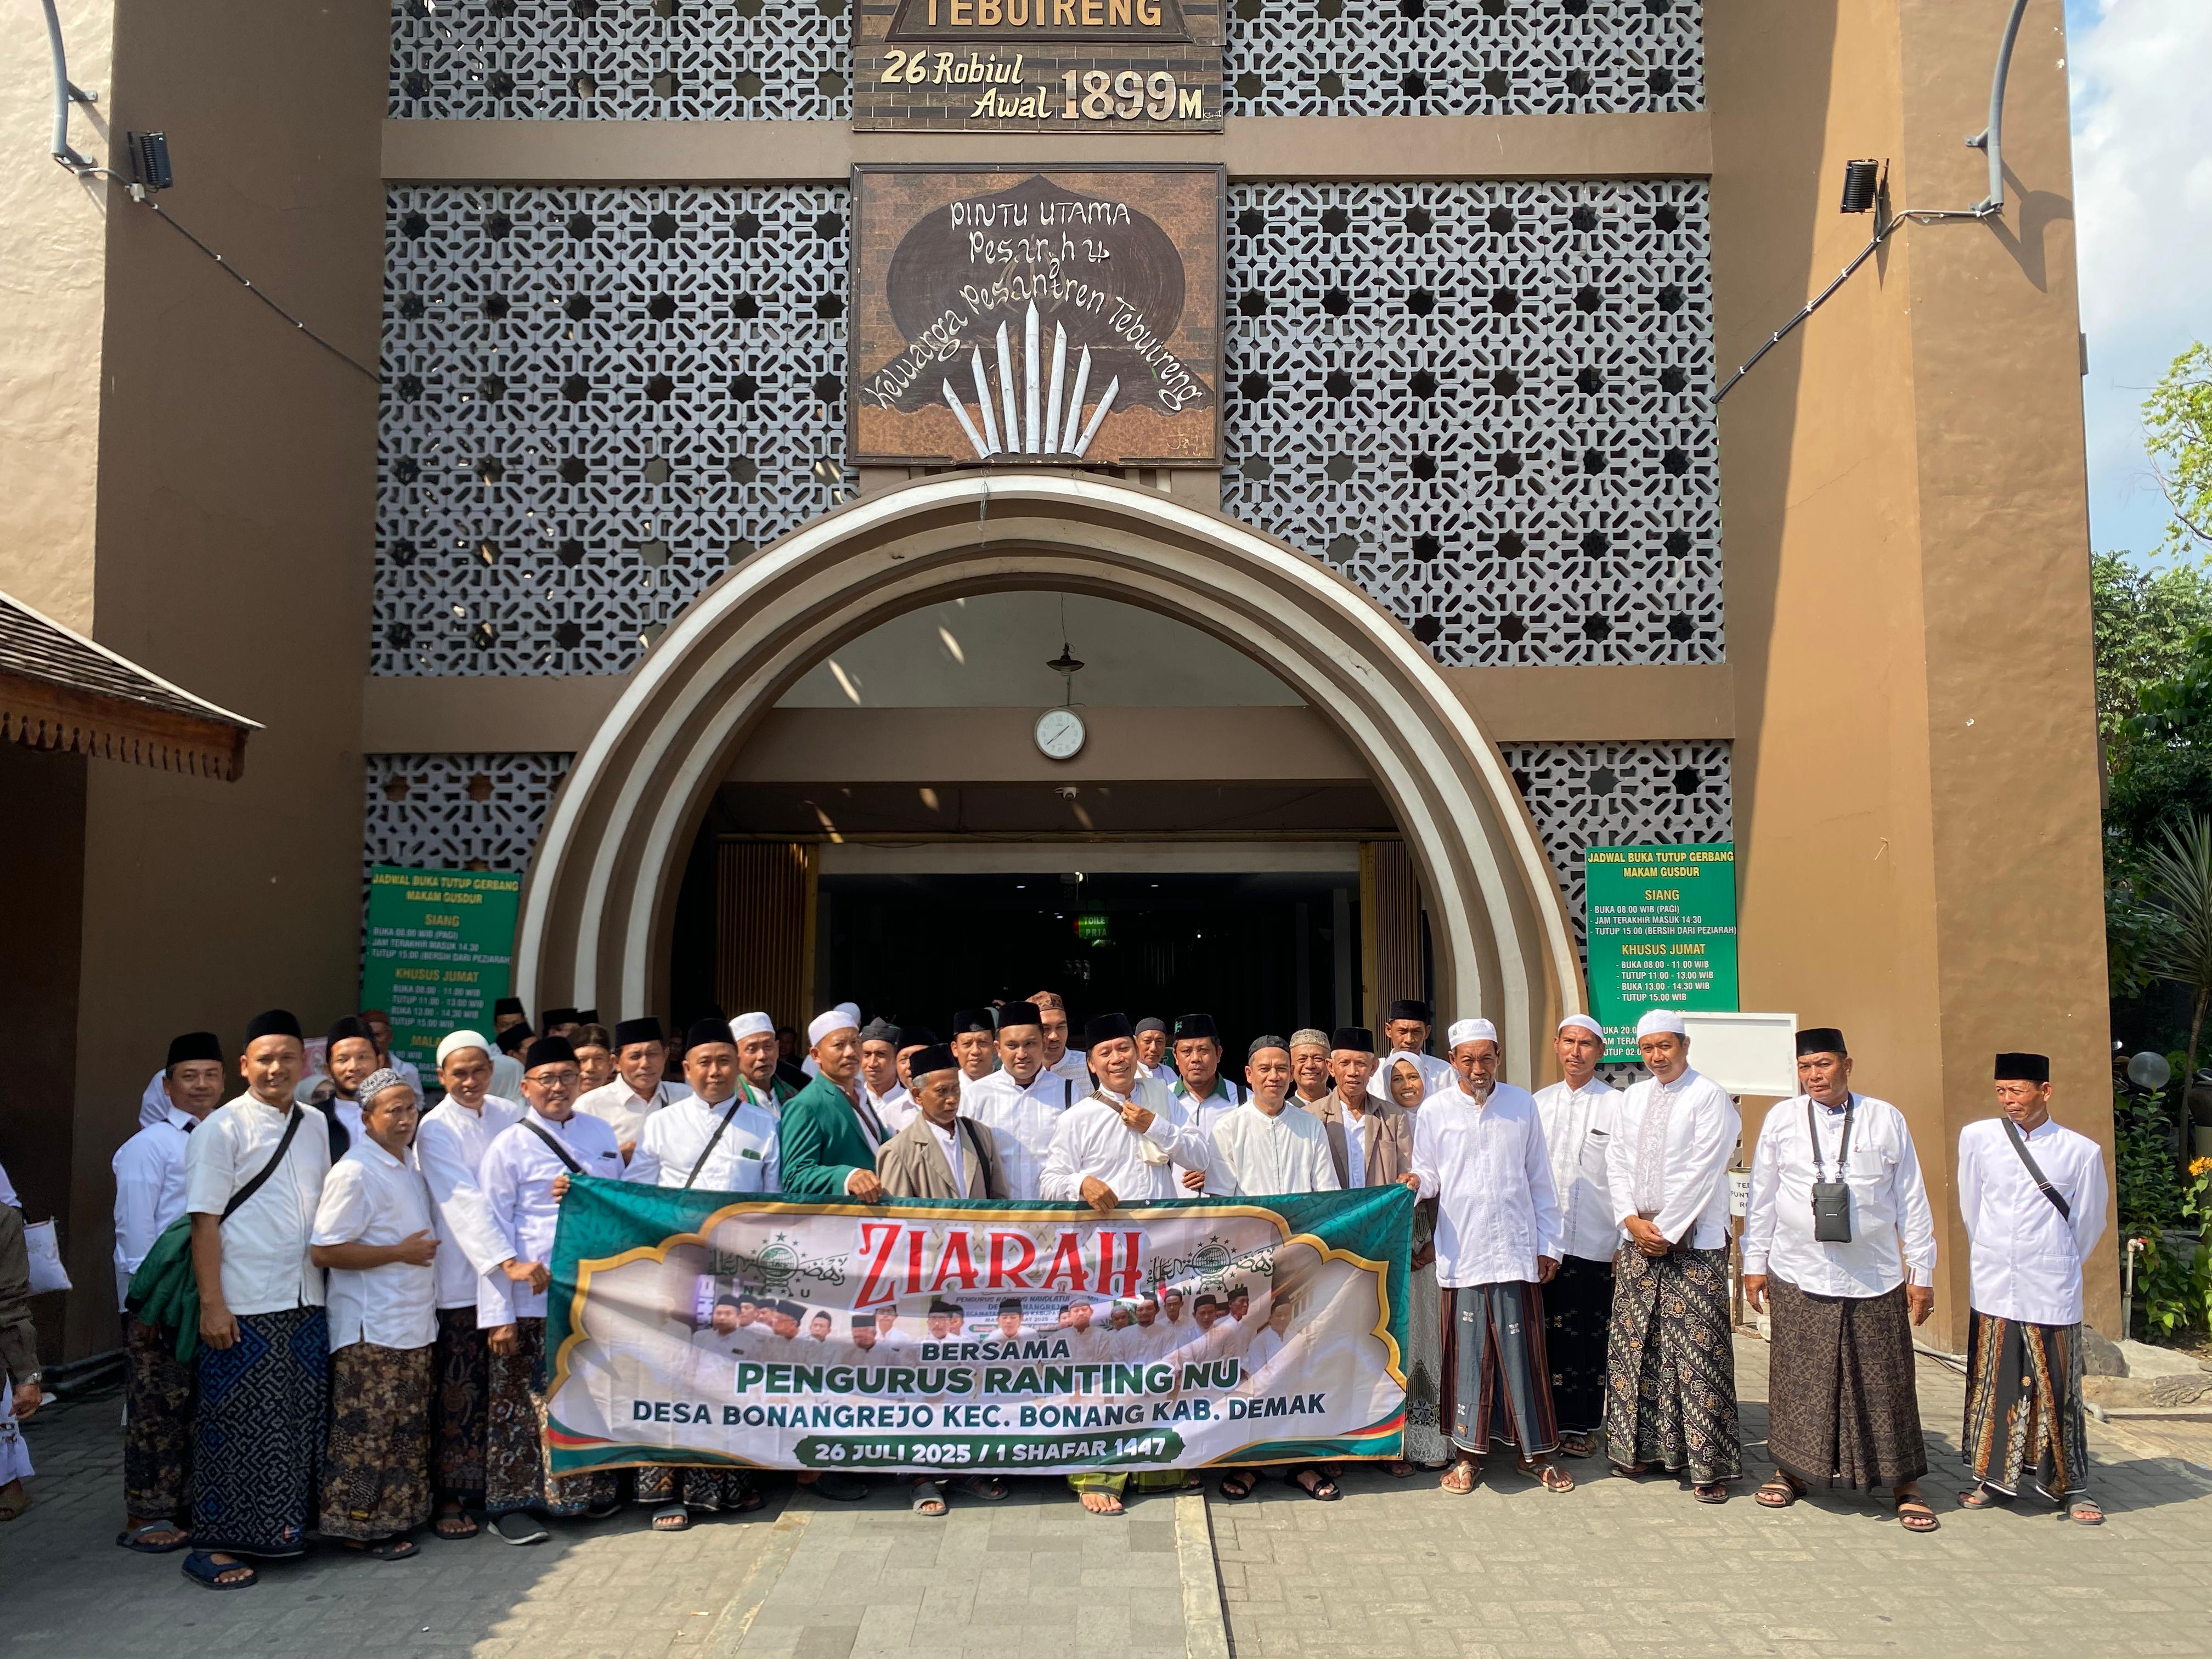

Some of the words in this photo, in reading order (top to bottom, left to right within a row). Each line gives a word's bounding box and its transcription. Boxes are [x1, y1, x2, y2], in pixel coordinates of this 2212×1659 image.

[881, 50, 927, 84] 26
[933, 52, 1024, 84] Robiul
[970, 86, 1053, 119] Awal
[951, 201, 1028, 230] PINTU
[1040, 201, 1131, 226] UTAMA
[864, 309, 969, 410] Keluarga
[1109, 296, 1203, 411] Tebuireng
[1588, 852, 1626, 863] JADWAL
[1628, 852, 1654, 863] BUKA
[1656, 852, 1686, 862] TUTUP
[1689, 851, 1734, 862] GERBANG
[1623, 867, 1658, 877] MAKAM
[1660, 867, 1700, 877] GUSDUR
[373, 873, 410, 885] JADWAL
[412, 875, 439, 887] BUKA
[441, 877, 472, 889] TUTUP
[473, 879, 518, 891] GERBANG
[407, 890, 441, 901] MAKAM
[443, 893, 483, 904] GUSDUR
[1645, 889, 1680, 900] SIANG
[1617, 905, 1638, 913] 08.00
[1657, 905, 1679, 914] (PAGI)
[425, 913, 460, 927] SIANG
[1084, 917, 1110, 925] TOILET
[1086, 928, 1107, 936] PRIA
[1645, 927, 1674, 936] (BERSIH
[1697, 926, 1737, 935] PEZIARAH)
[1622, 944, 1667, 955] KHUSUS
[1669, 944, 1706, 955] JUMAT
[1694, 960, 1709, 968] WIB
[396, 968, 439, 980] KHUSUS
[442, 970, 479, 983] JUMAT
[1622, 972, 1646, 980] TUTUP
[1622, 983, 1642, 991] BUKA
[1602, 1026, 1619, 1034] UKA
[1621, 1026, 1637, 1034] 20.0
[1602, 1037, 1615, 1045] AM
[852, 1222, 1143, 1310] ZIARAH
[922, 1339, 1070, 1361] BERSAMA
[737, 1363, 974, 1394] PENGURUS
[984, 1363, 1174, 1394] RANTING
[1183, 1359, 1240, 1390] NU
[633, 1400, 712, 1425] DESA
[723, 1404, 934, 1427] BONANGREJO
[944, 1404, 1011, 1427] KEC.
[1020, 1403, 1144, 1427] BONANG
[1152, 1398, 1220, 1421] KAB.
[1229, 1393, 1325, 1420] DEMAK
[815, 1443, 845, 1460] 26
[851, 1444, 905, 1461] JULI
[911, 1443, 970, 1463] 2025
[996, 1443, 1005, 1461] 1
[1012, 1439, 1107, 1460] SHAFAR
[1114, 1437, 1166, 1457] 1447
